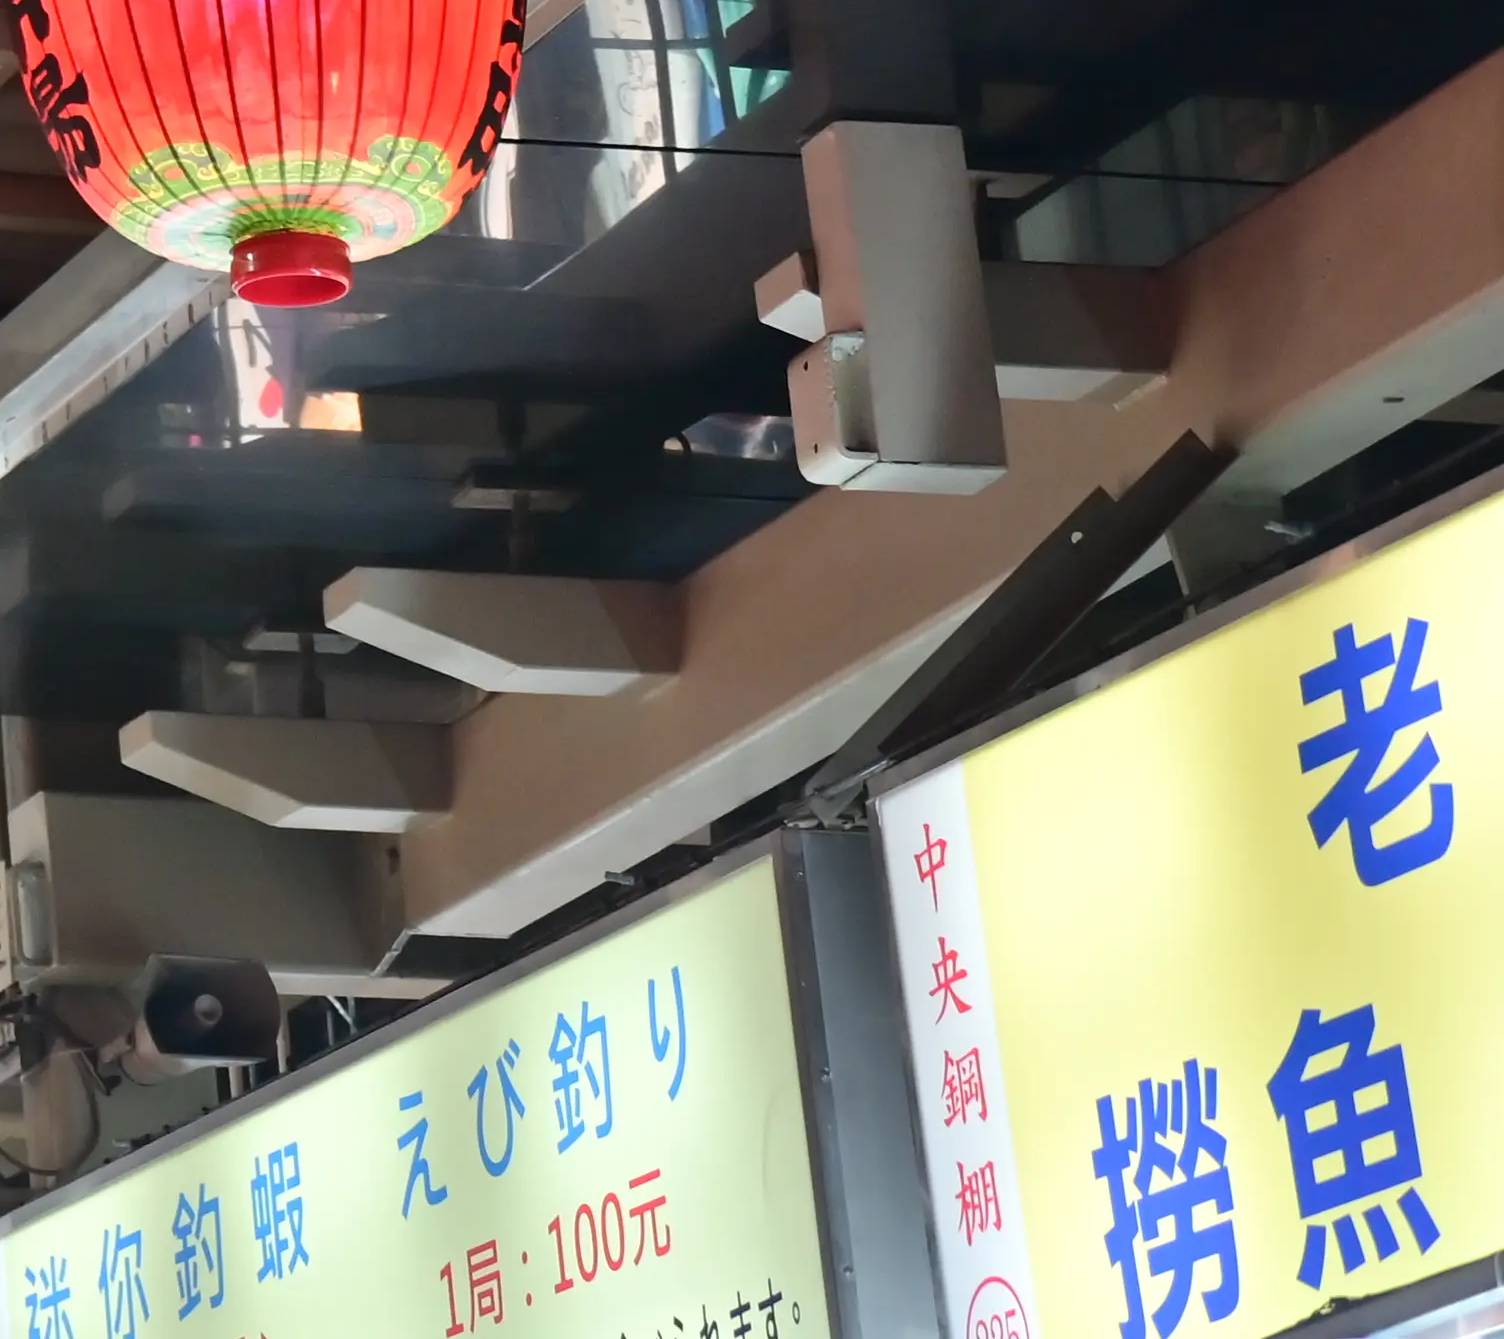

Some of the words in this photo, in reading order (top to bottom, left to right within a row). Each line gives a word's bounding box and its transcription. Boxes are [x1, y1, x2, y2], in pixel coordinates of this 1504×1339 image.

[1302, 619, 1454, 885] 老
[25, 1142, 310, 1339] 迷你釣蝦
[396, 966, 688, 1218] えび釣り
[914, 823, 1003, 1245] 中央鋼棚
[1092, 1003, 1441, 1339] 撈魚
